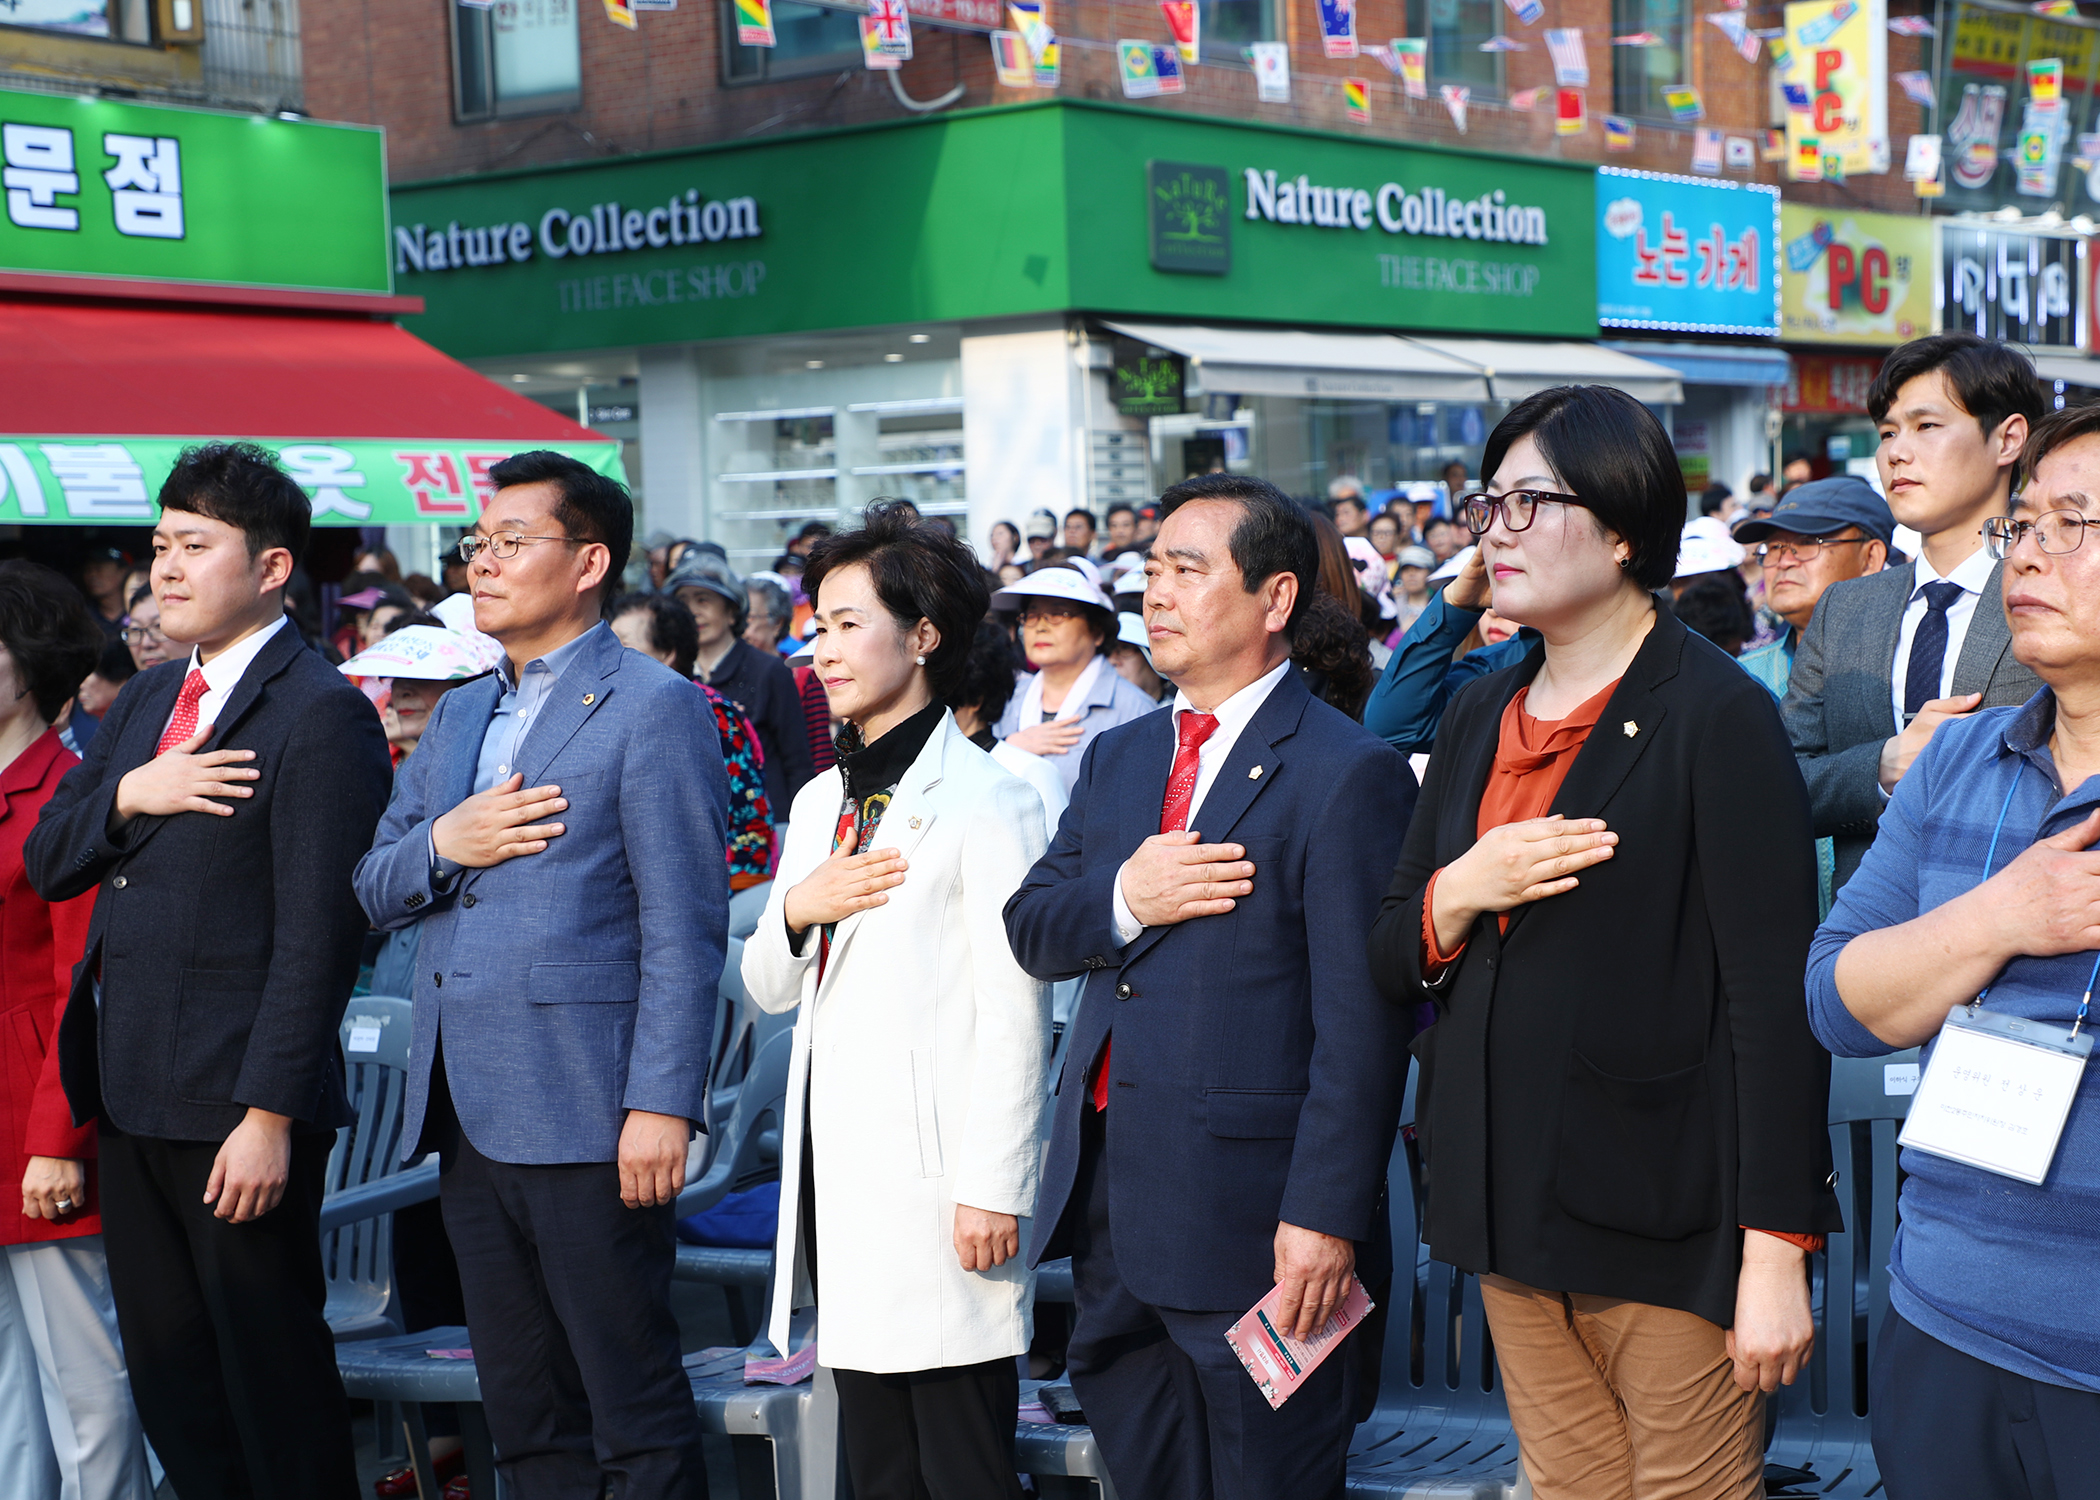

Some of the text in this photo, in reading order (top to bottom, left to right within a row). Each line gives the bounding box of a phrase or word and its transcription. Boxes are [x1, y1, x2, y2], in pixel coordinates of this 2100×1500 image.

[394, 188, 762, 274] Nature Collection
[1244, 167, 1549, 245] Nature Collection
[686, 259, 767, 301] SHOP
[1481, 262, 1540, 297] SHOP
[1635, 213, 1687, 284] 노는
[1697, 226, 1759, 291] 가게
[1828, 243, 1890, 314] PC
[1953, 1066, 1991, 1086] 운영위원
